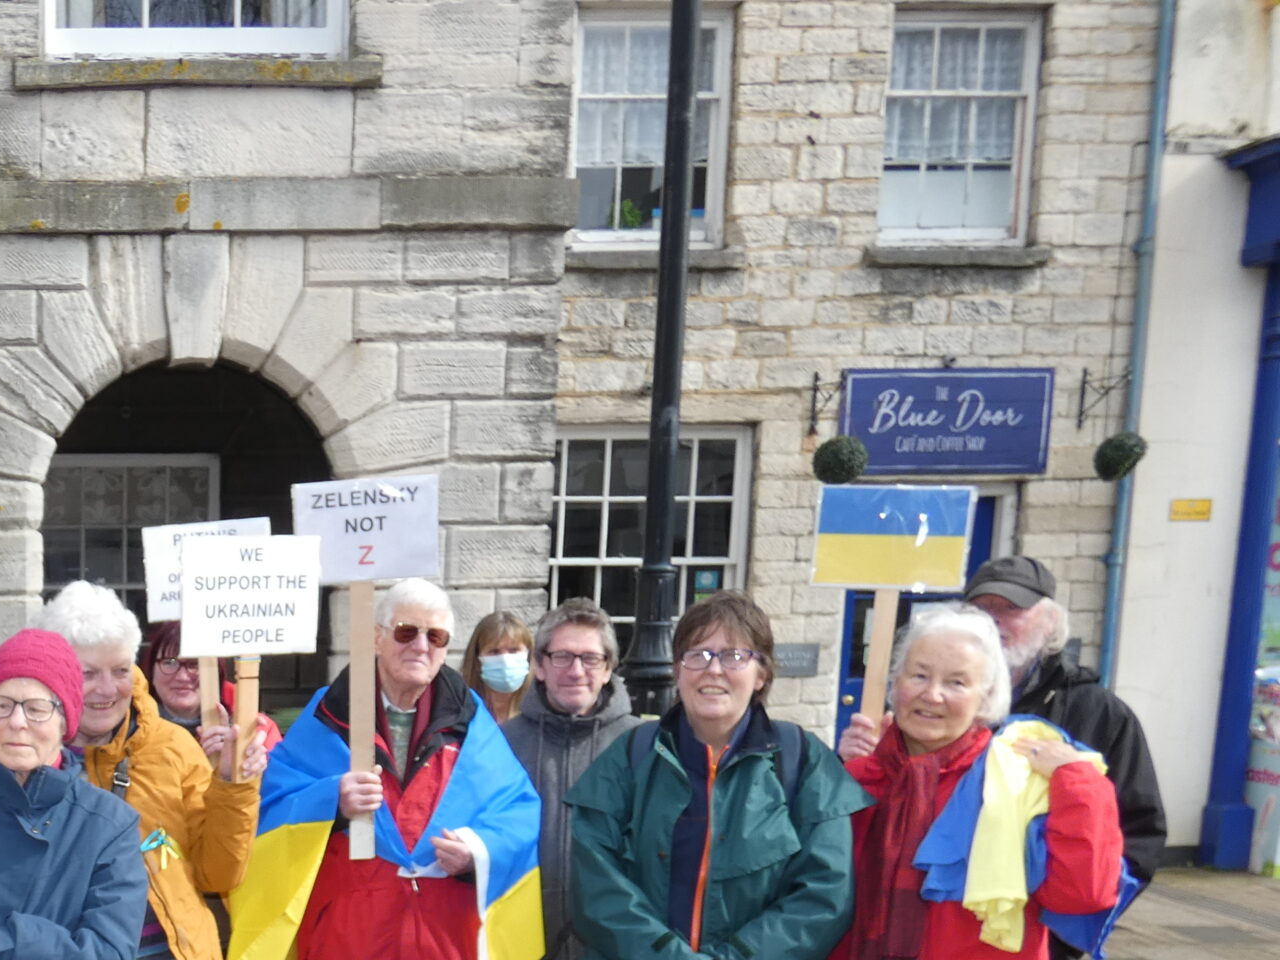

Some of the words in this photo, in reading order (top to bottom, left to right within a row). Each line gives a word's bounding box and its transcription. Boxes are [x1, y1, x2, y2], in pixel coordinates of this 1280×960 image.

[868, 389, 945, 434] Blue
[949, 389, 1024, 433] Door
[345, 516, 387, 533] NOT
[240, 547, 264, 562] WE
[358, 545, 375, 565] Z
[194, 575, 271, 591] SUPPORT
[277, 574, 308, 590] THE
[205, 602, 296, 619] UKRAINIAN
[221, 628, 285, 644] PEOPLE
